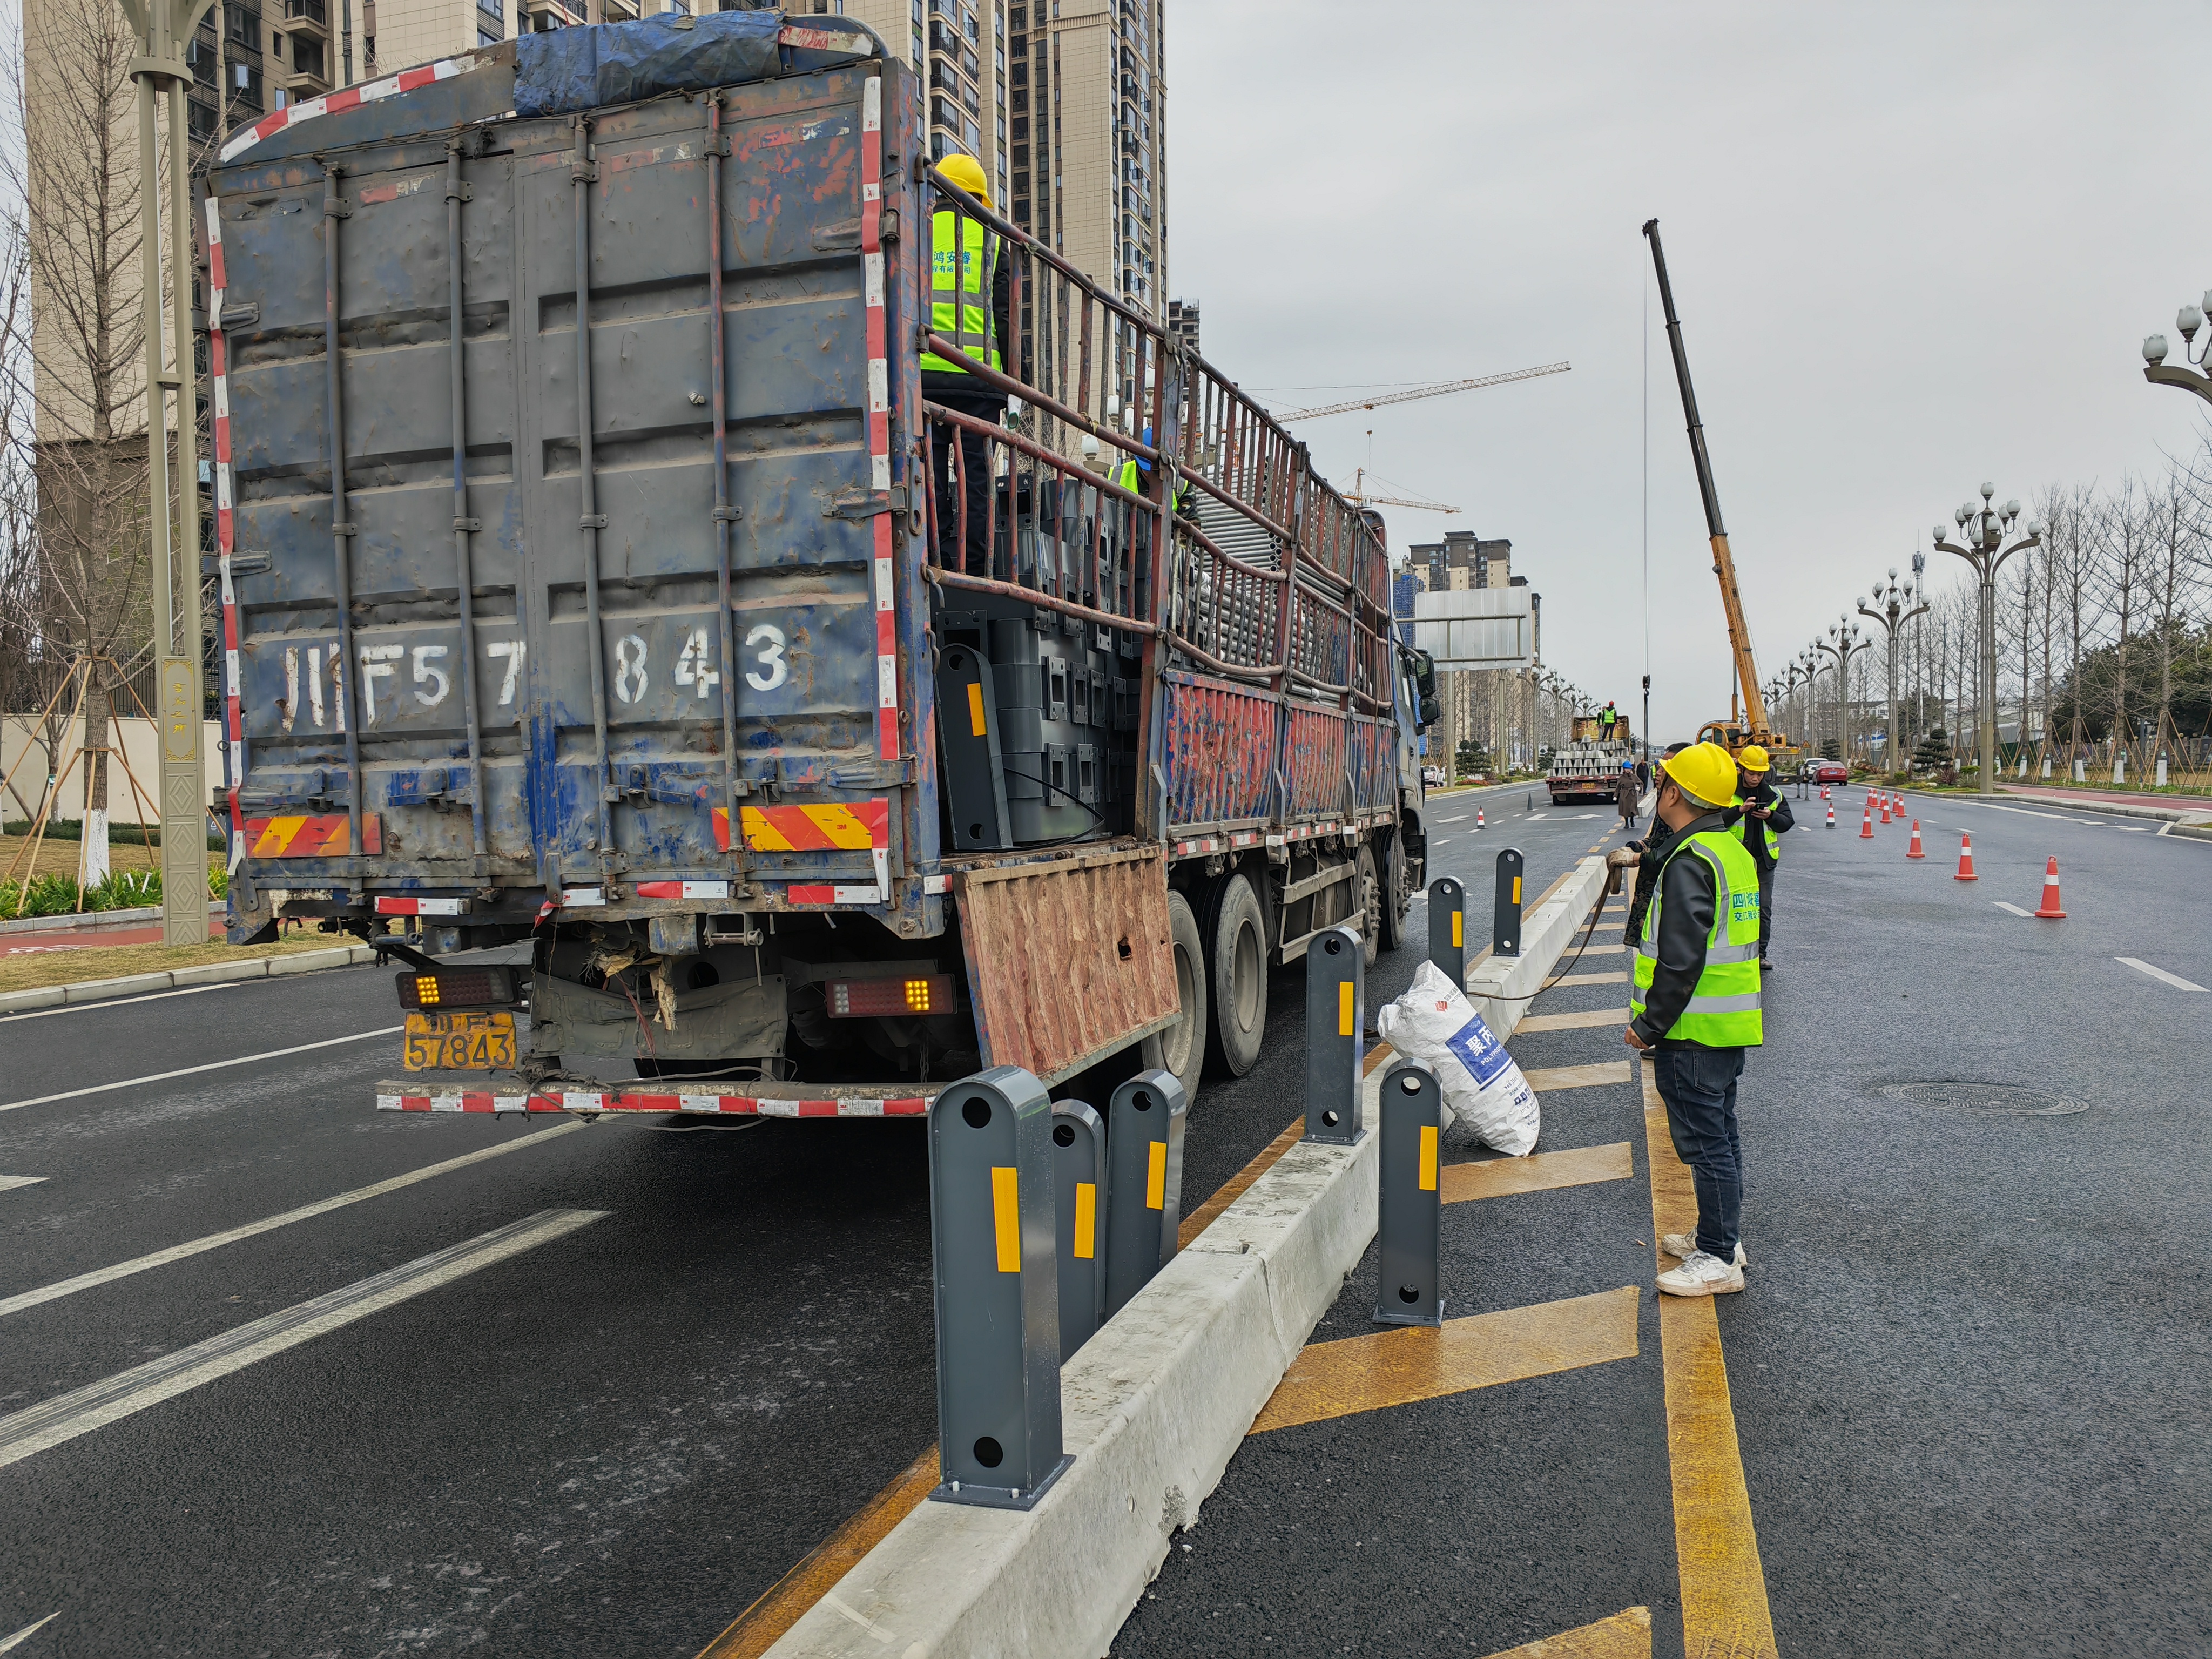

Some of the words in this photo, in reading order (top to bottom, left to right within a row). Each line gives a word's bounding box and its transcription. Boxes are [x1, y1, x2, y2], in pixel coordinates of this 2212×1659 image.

[933, 265, 970, 274] 程有限司
[409, 1034, 510, 1068] 57843
